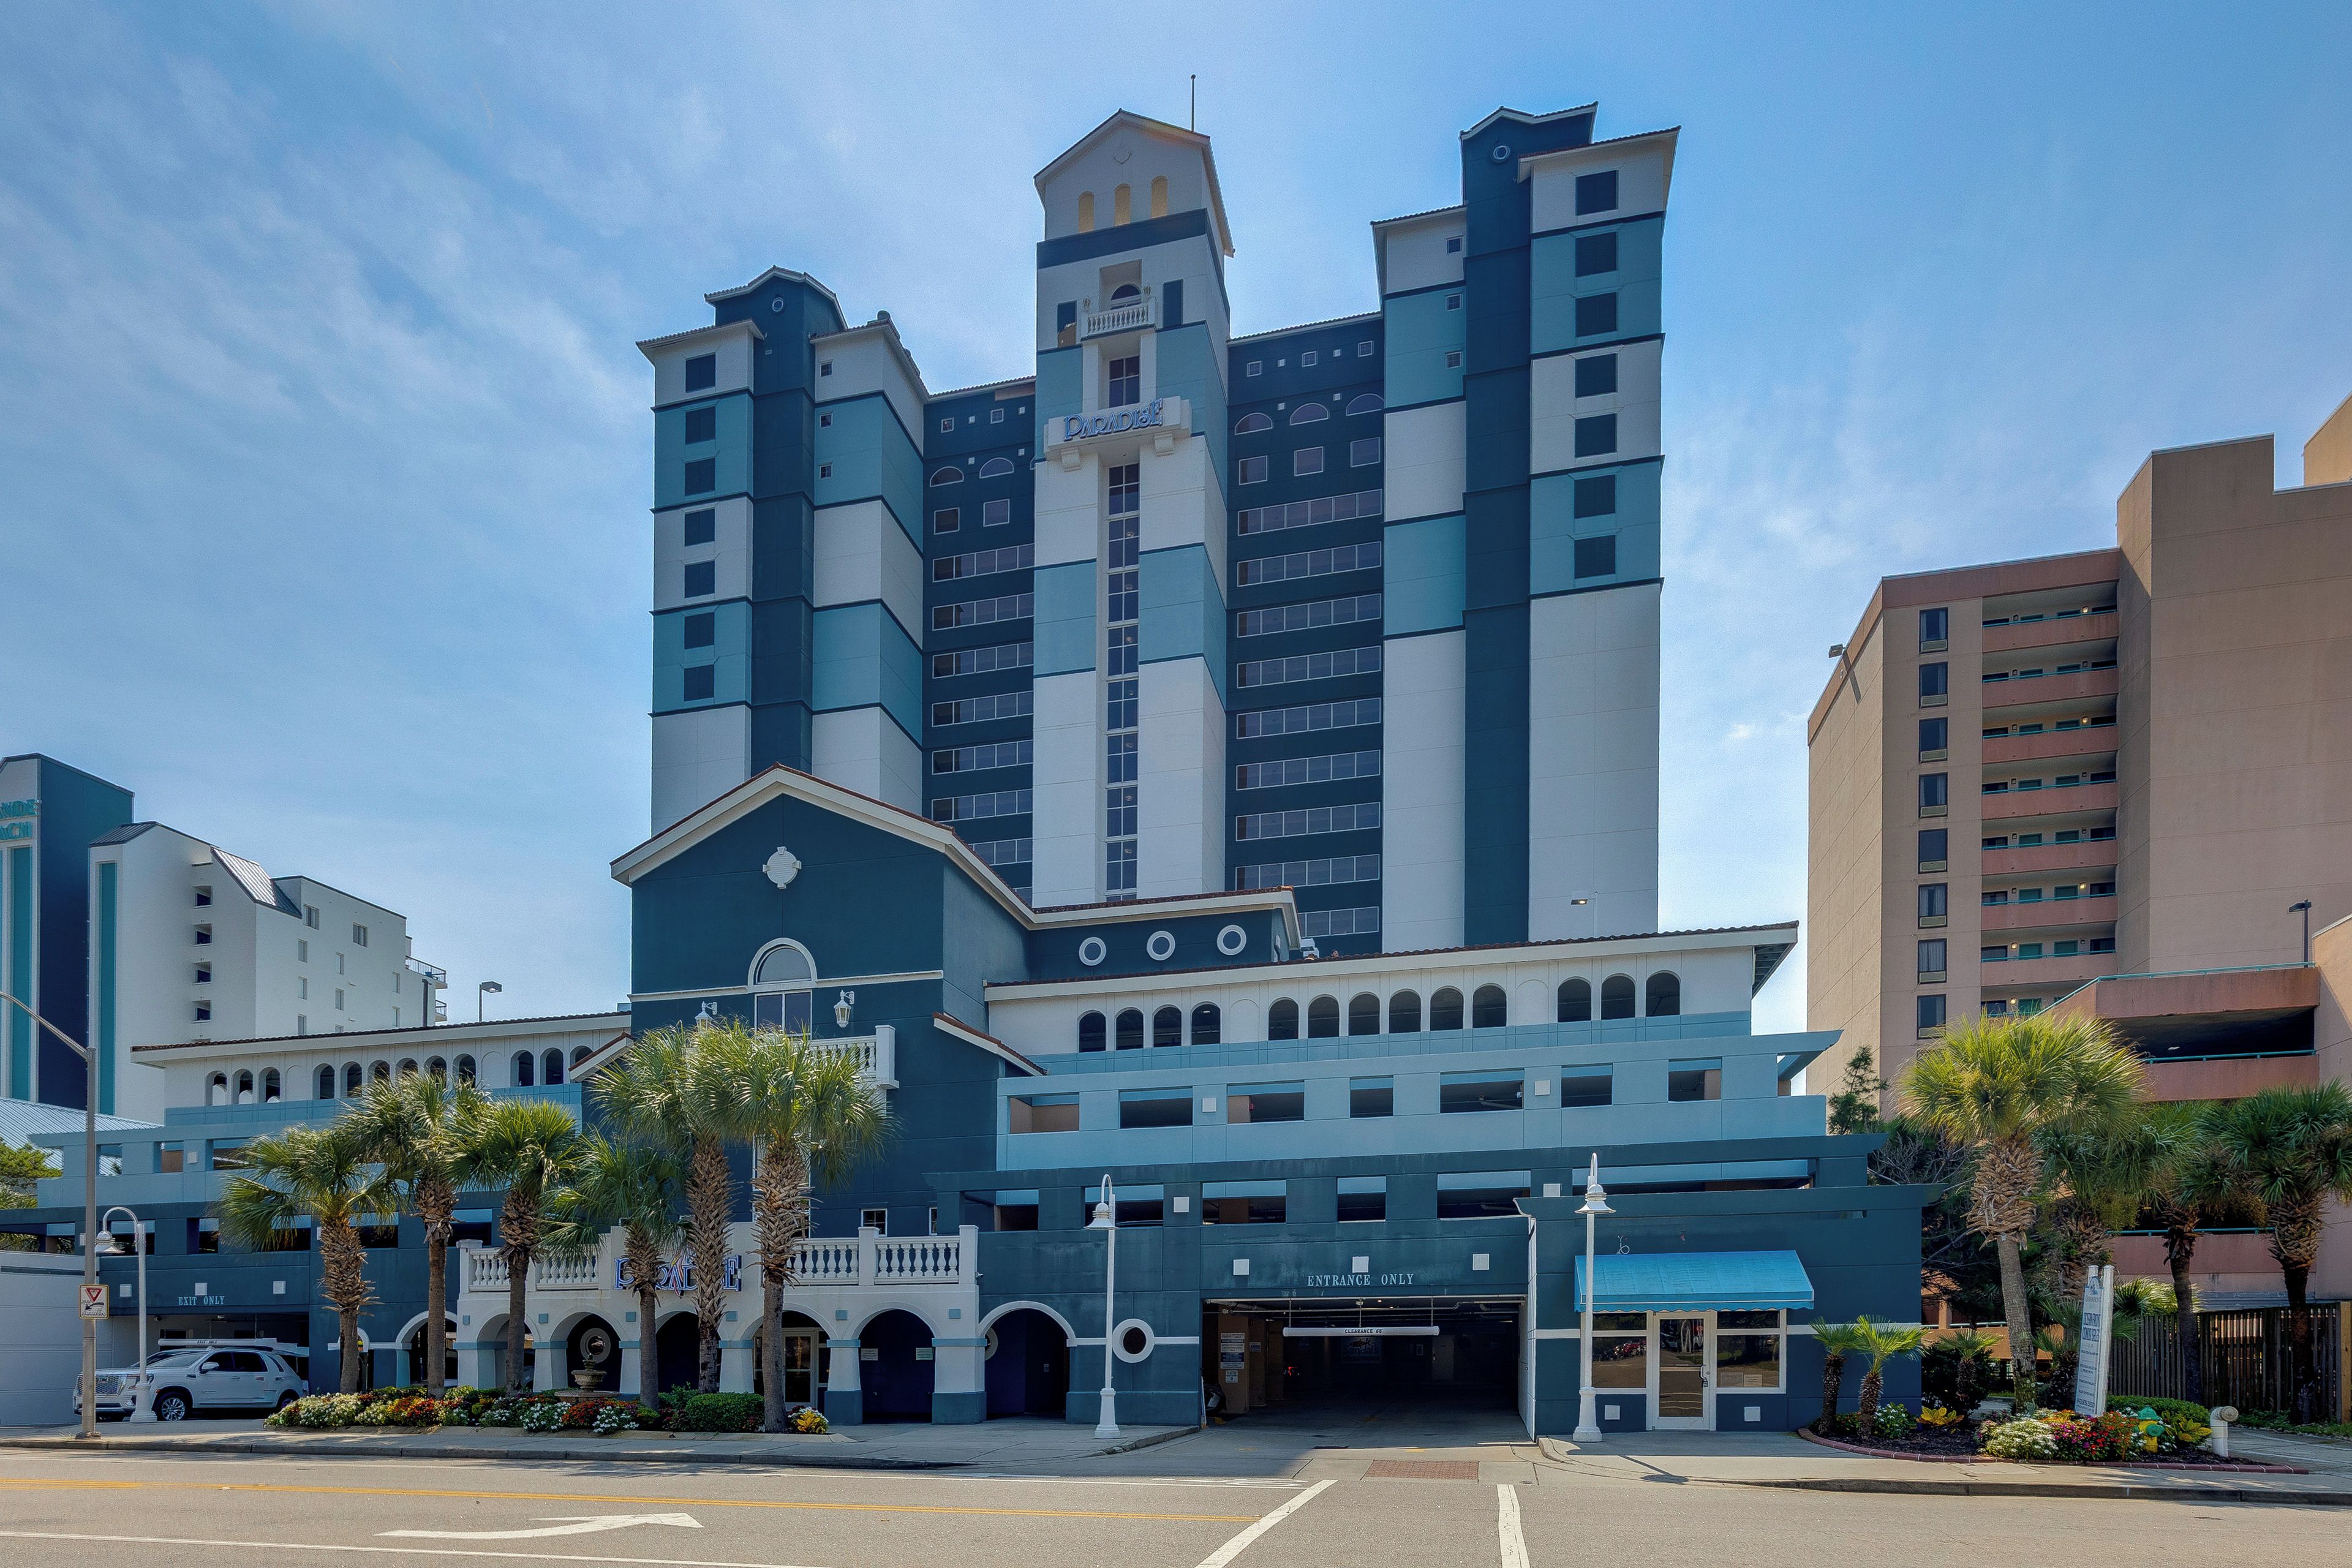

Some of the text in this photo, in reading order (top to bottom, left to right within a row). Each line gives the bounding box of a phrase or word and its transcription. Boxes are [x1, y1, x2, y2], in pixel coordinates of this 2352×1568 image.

[1063, 398, 1164, 441] PARADISE
[1307, 1273, 1414, 1286] ENTRANCE ONLY
[178, 1295, 225, 1306] EXIT ONLY
